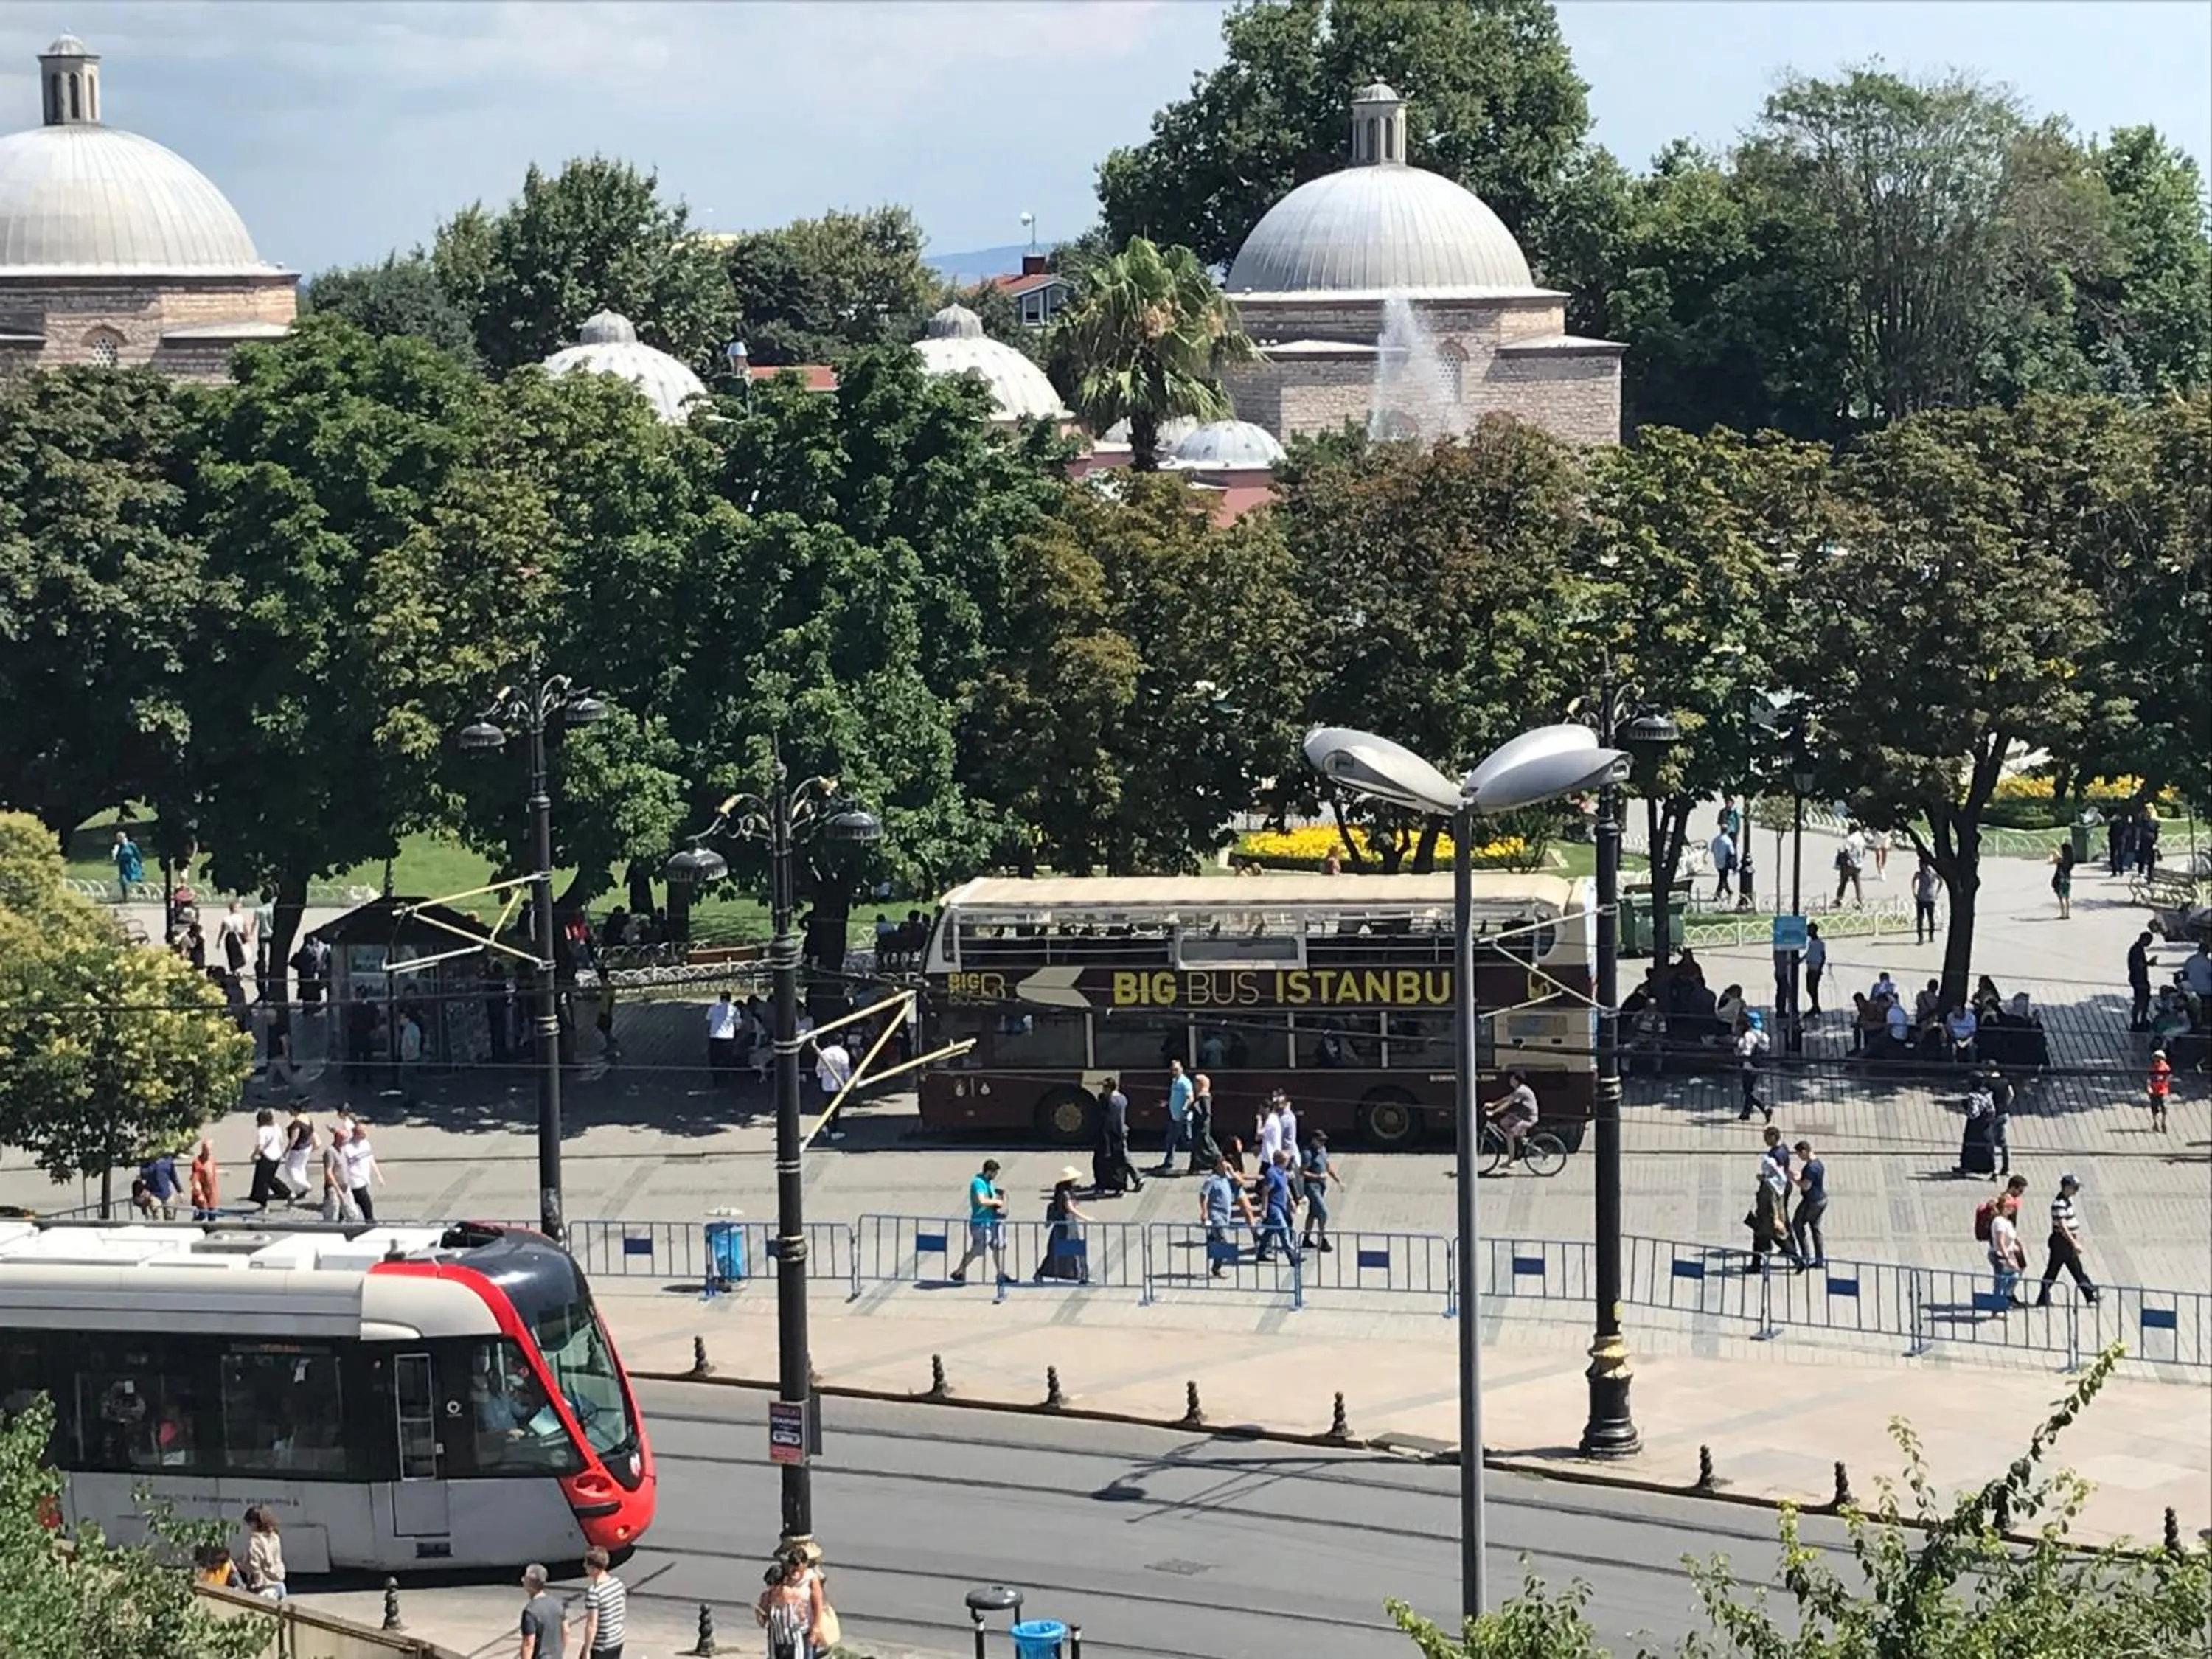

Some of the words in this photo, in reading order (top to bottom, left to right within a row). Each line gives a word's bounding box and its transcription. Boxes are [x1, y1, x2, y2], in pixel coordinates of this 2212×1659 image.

[948, 973, 980, 990] BIG
[1113, 971, 1177, 1004] BIG
[1188, 970, 1260, 1004] BUS
[1275, 970, 1451, 1004] ISTANBU
